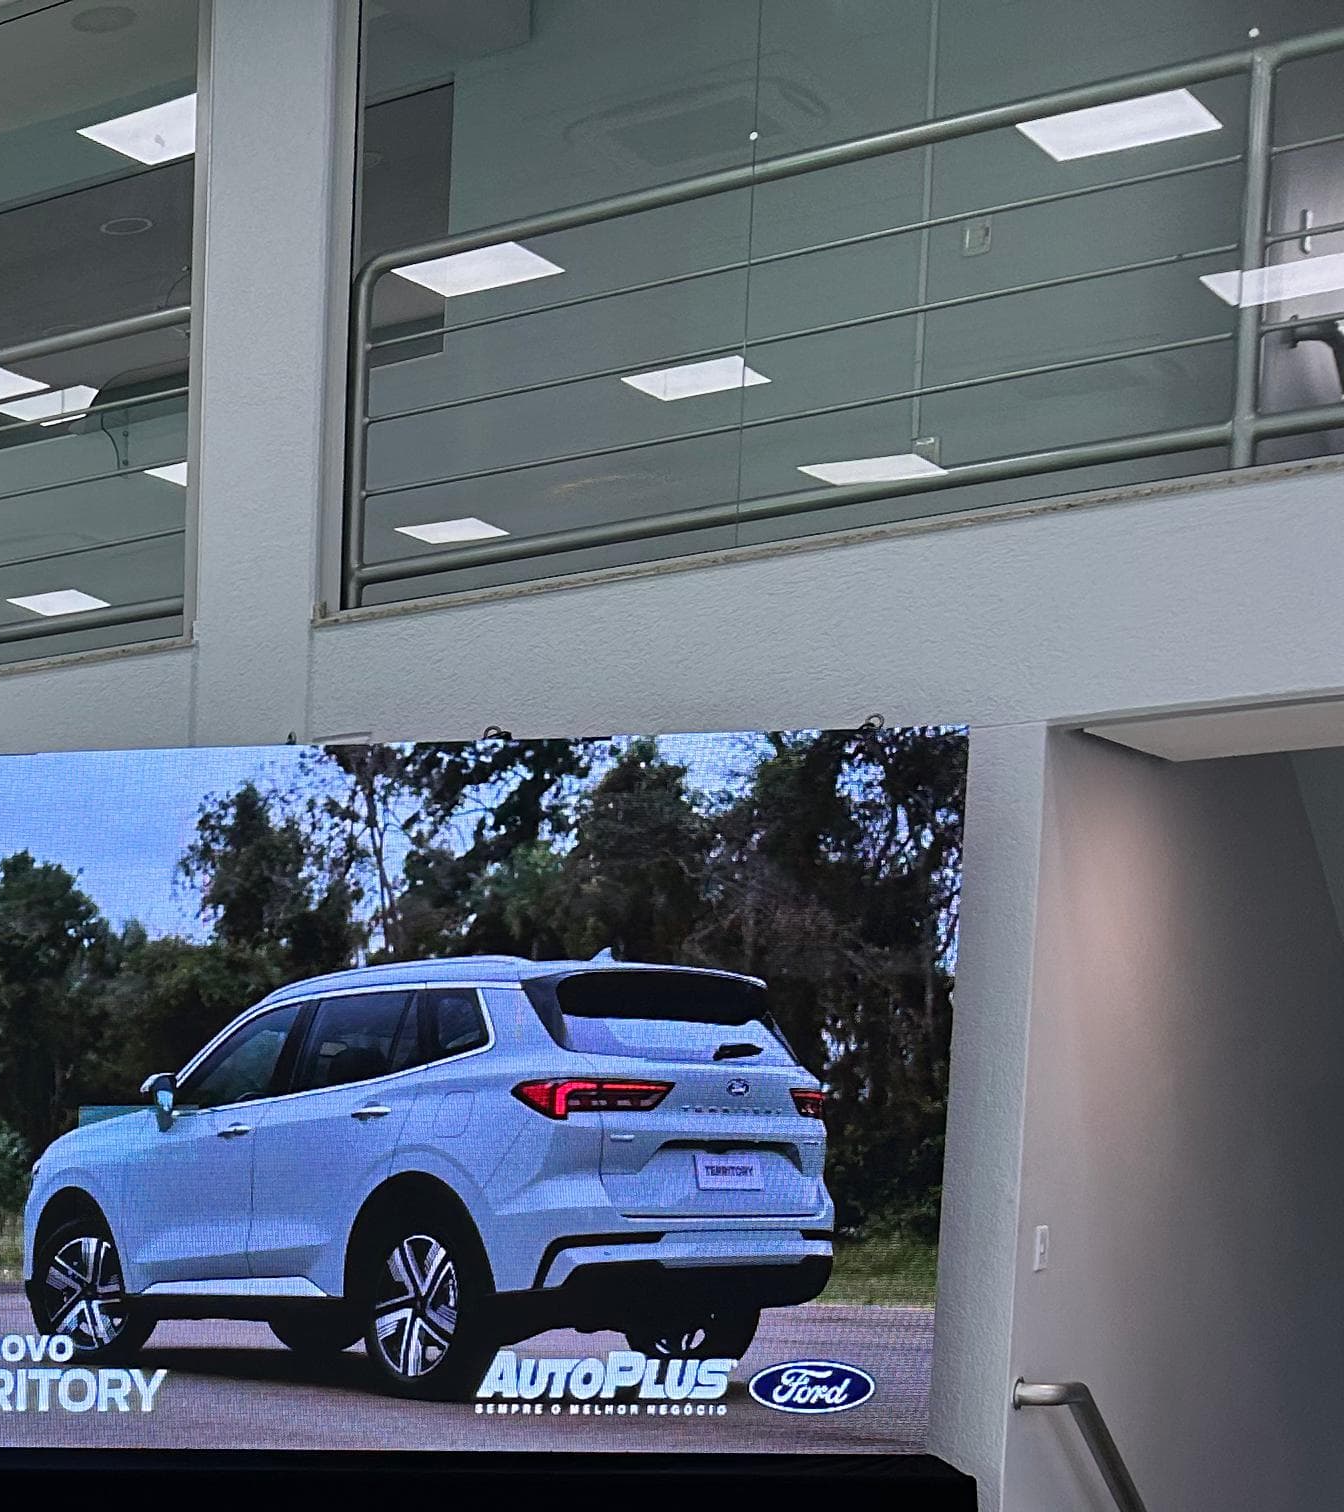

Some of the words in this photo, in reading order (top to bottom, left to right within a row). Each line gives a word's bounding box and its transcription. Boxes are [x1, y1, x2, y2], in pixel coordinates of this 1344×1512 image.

[772, 1370, 848, 1404] Ford
[474, 1404, 543, 1414] SEMPRE
[551, 1404, 561, 1415] O
[569, 1403, 638, 1415] MELHOR
